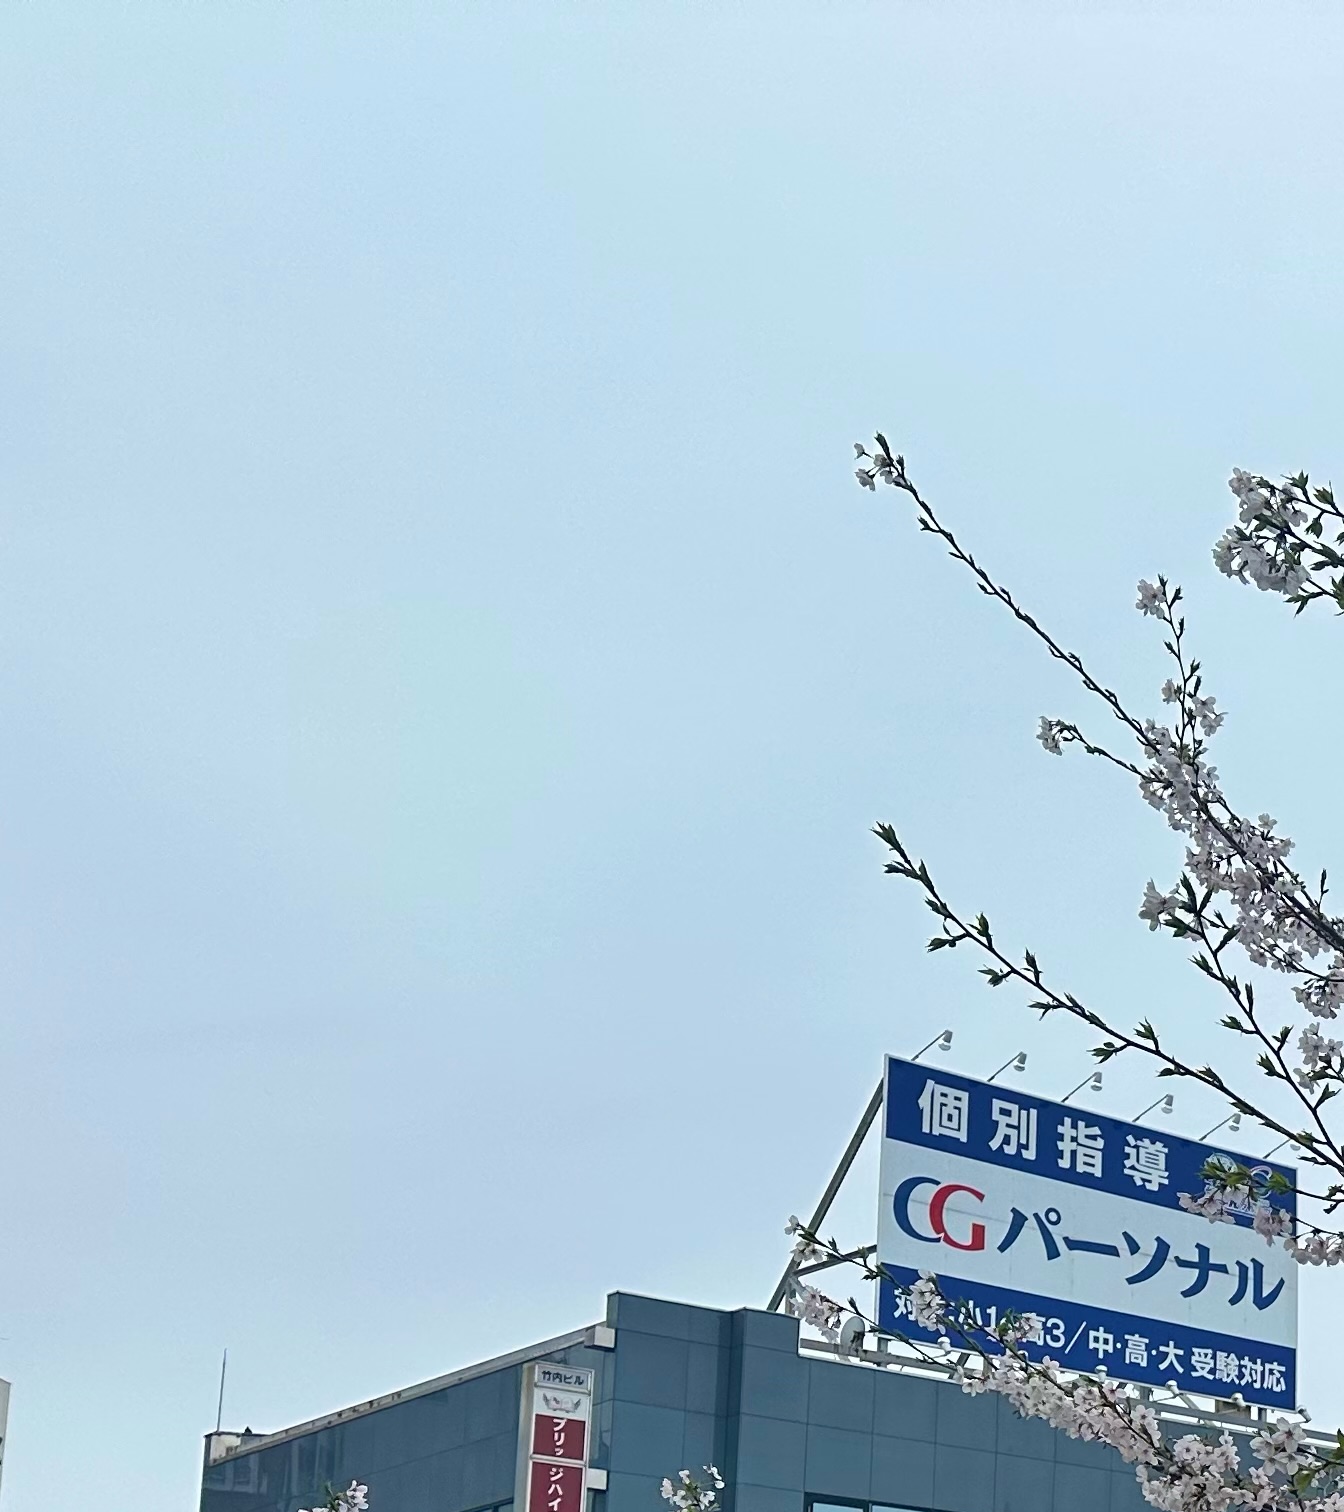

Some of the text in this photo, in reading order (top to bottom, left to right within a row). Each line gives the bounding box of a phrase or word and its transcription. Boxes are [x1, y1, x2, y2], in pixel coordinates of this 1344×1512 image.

[918, 1078, 1170, 1193] 個別指導
[893, 1175, 1286, 1312] CG パーソナル
[541, 1370, 585, 1387] 竹内ビル
